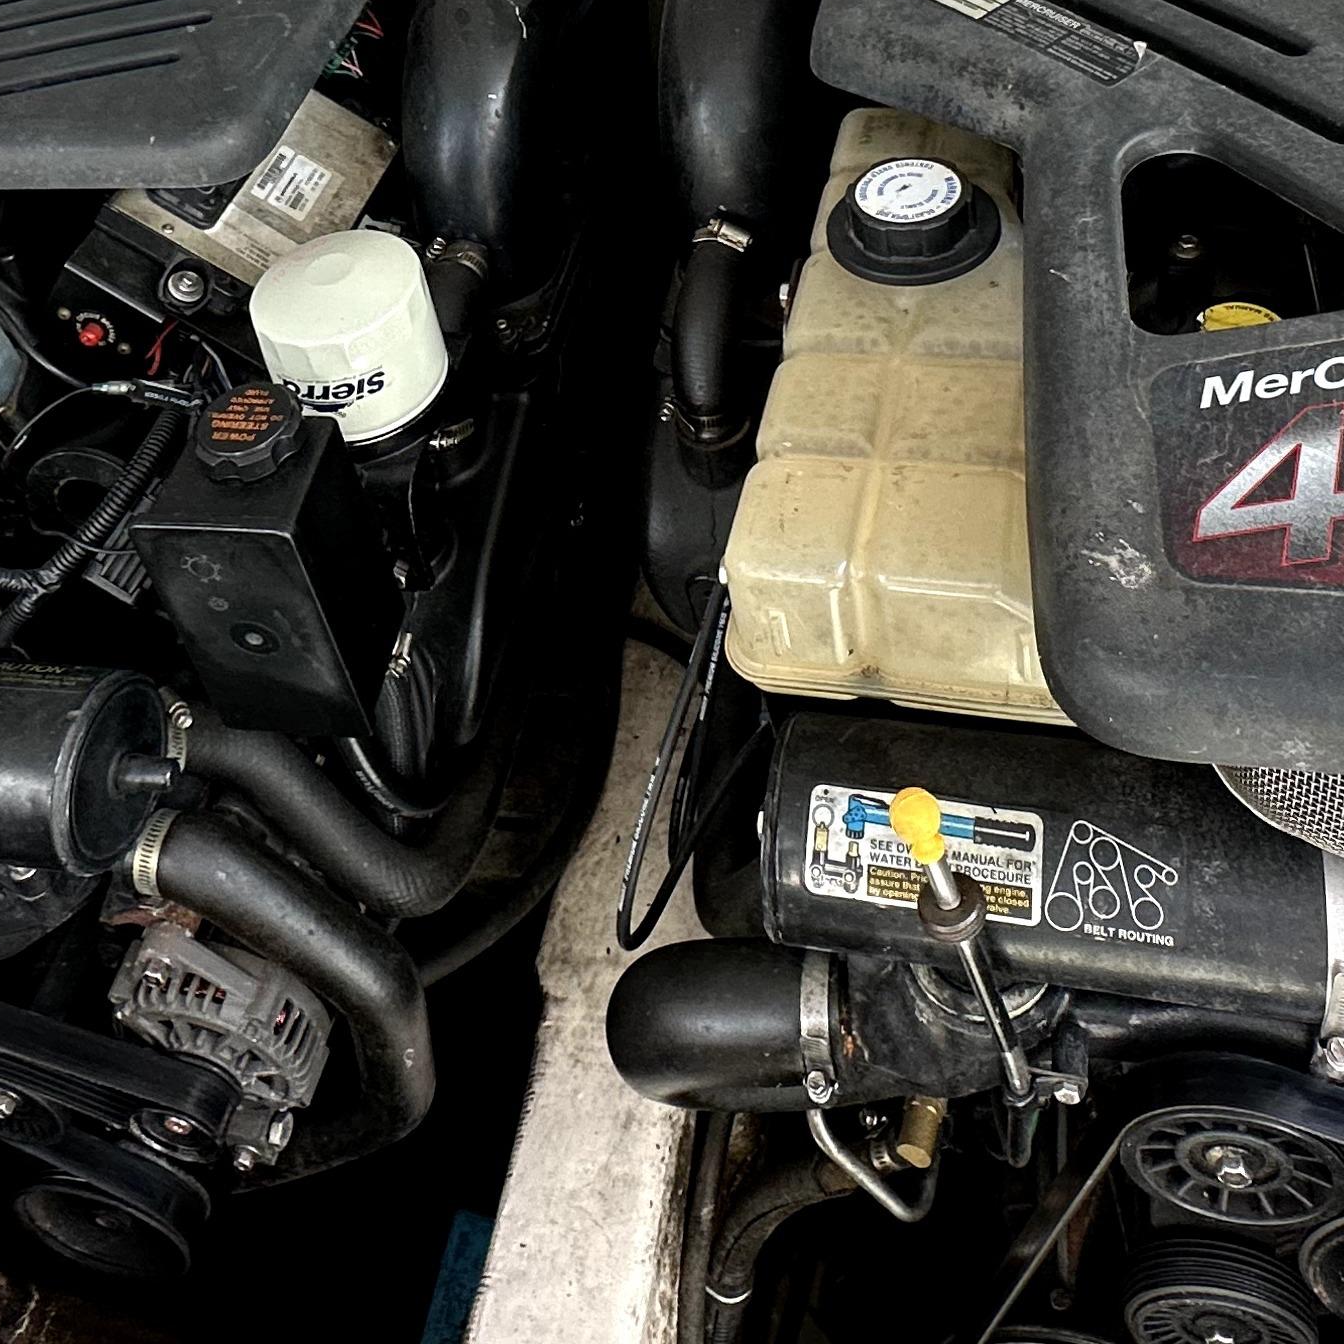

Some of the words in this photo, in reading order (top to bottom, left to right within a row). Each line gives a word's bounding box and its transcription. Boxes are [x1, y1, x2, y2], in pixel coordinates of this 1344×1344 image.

[282, 371, 385, 401] Sierra
[211, 431, 257, 442] POWER
[869, 838, 893, 853] SEE
[951, 850, 1003, 868] MANUAL
[1006, 858, 1032, 872] FOR
[869, 851, 912, 868] WATER
[956, 863, 1032, 885] PROCEDURE
[997, 896, 1030, 908] closed
[1083, 923, 1116, 938] BELT
[1117, 928, 1175, 947] ROUTING
